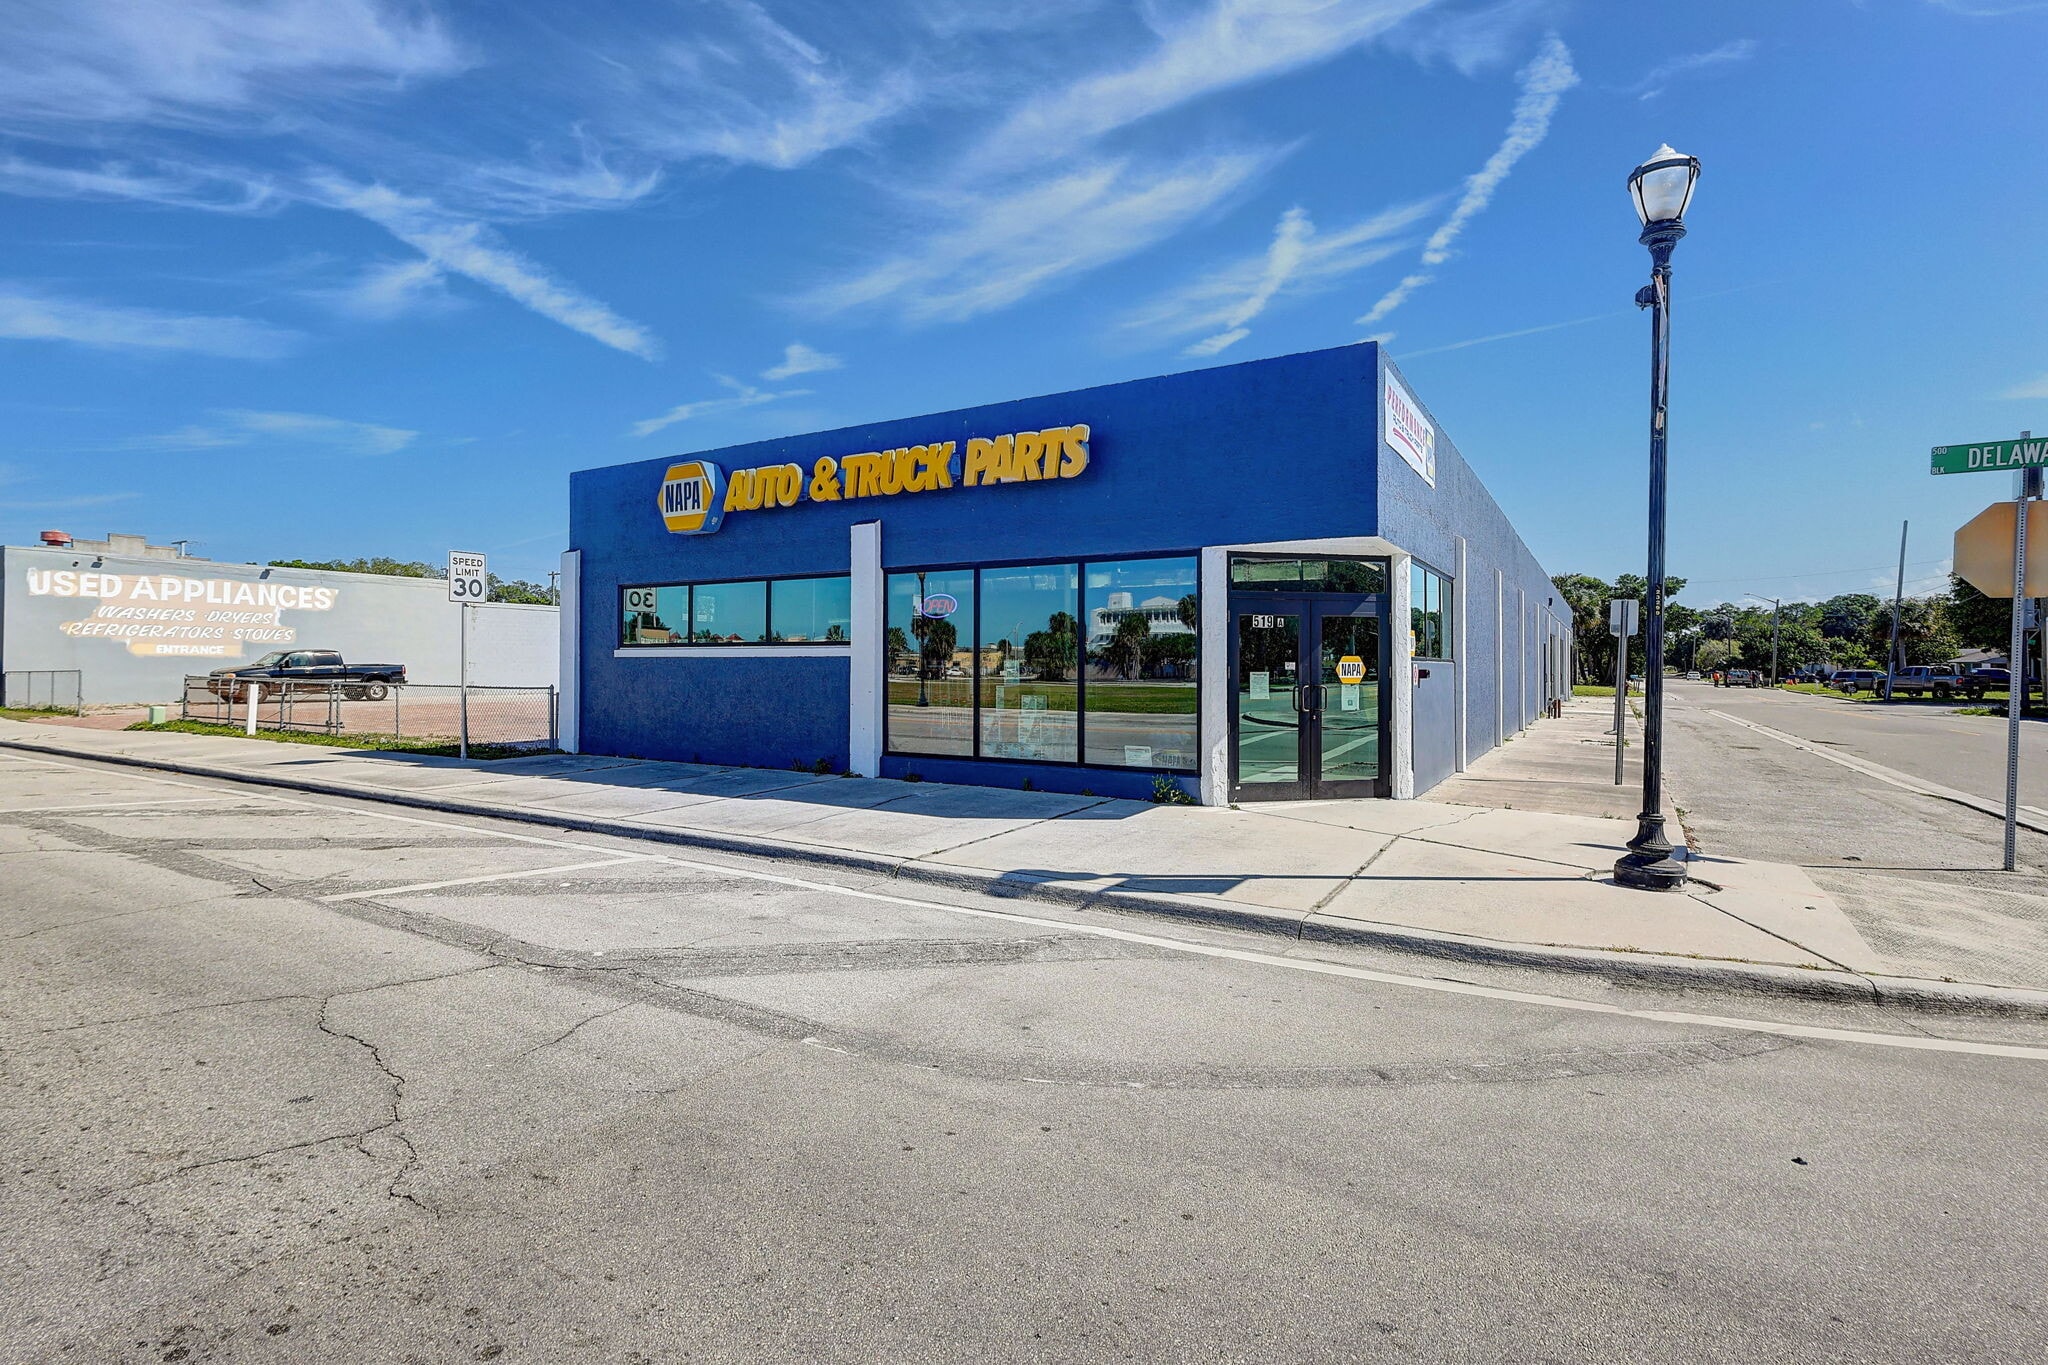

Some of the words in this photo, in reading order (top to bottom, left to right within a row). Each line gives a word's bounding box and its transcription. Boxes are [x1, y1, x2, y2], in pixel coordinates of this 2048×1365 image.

[1932, 447, 1948, 456] 500
[723, 463, 803, 513] AUTO
[808, 456, 842, 503] &
[841, 440, 956, 500] TRUCK
[963, 423, 1091, 488] PARTS
[1931, 466, 1945, 475] BLK
[665, 480, 701, 513] NAPA
[452, 557, 483, 567] SPEED
[455, 567, 480, 577] LIMIT
[29, 570, 124, 598] USED
[129, 574, 332, 609] APPLIANCES
[453, 577, 483, 598] 30
[923, 599, 954, 613] OPEN
[98, 605, 196, 622] WASHERS
[207, 610, 274, 625] DRYERS
[1253, 615, 1273, 628] 519
[1277, 618, 1284, 628] A
[66, 622, 225, 639] REFRIGERATORS
[233, 627, 294, 641] STOVES
[156, 644, 225, 655] ENTRANCE
[1341, 663, 1361, 677] NAPA
